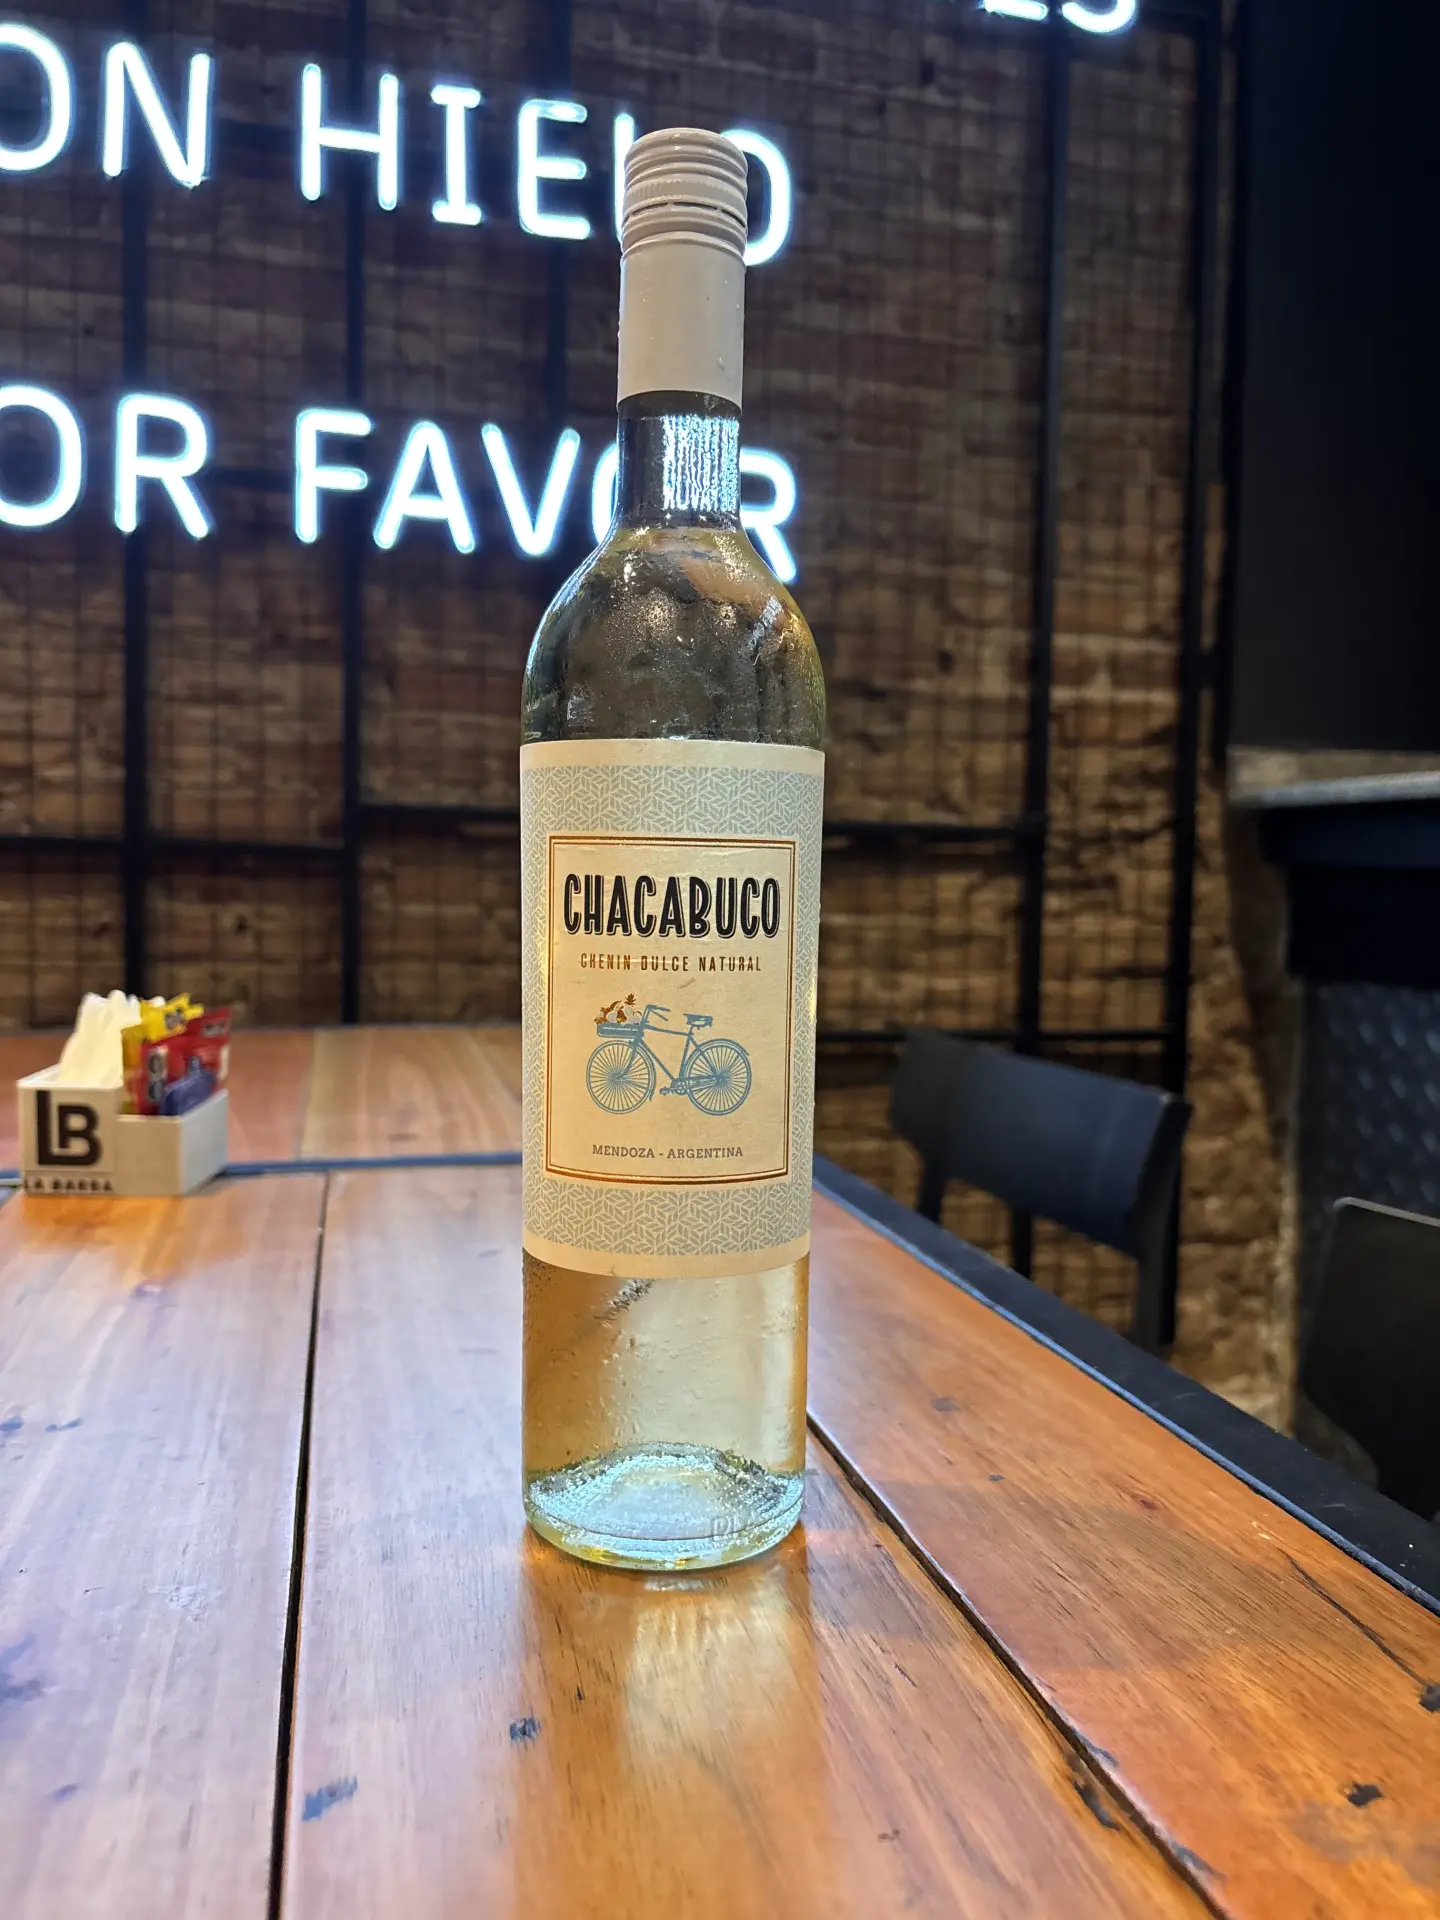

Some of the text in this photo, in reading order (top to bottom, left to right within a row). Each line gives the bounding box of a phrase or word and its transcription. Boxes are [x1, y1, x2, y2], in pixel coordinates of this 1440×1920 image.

[293, 407, 798, 584] FAVR
[563, 873, 781, 939] CHACABUCO
[581, 953, 762, 972] CHENIN DULCE NATURAL
[591, 1144, 655, 1158] MENDOZA
[667, 1146, 743, 1159] ARGENTINA
